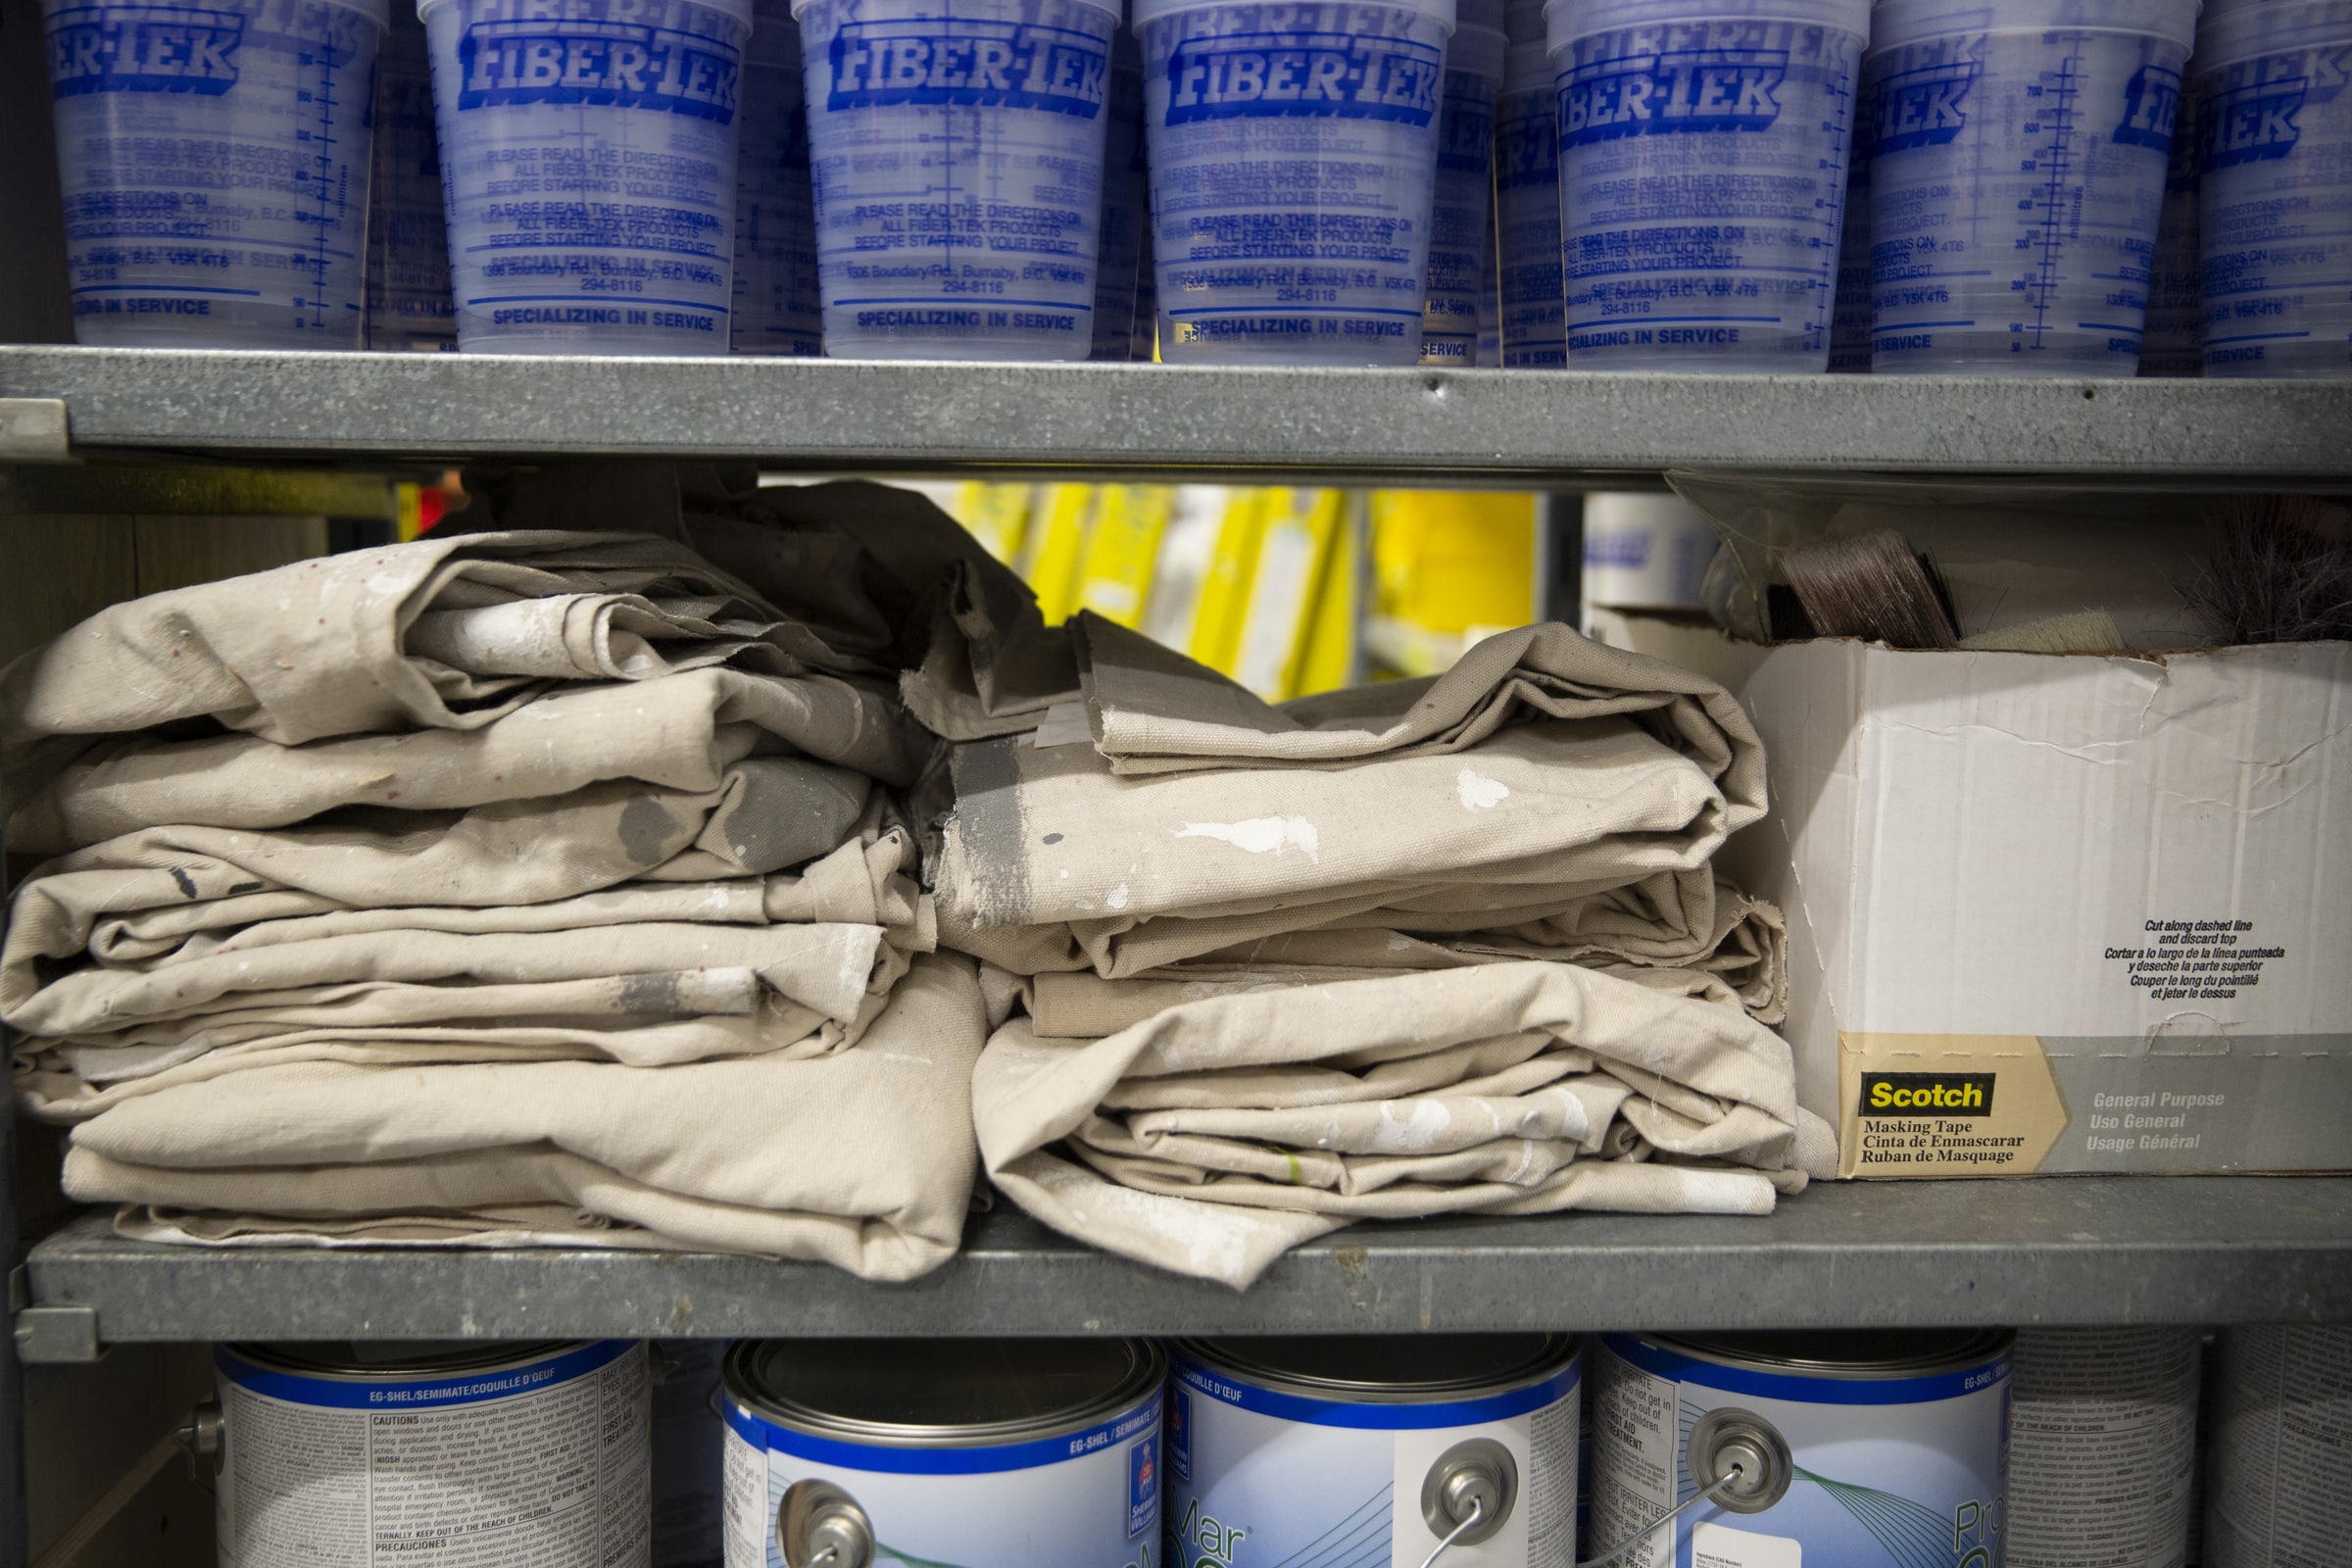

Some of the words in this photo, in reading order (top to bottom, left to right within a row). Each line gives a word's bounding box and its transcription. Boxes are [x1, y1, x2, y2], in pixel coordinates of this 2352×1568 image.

[463, 20, 739, 114] FIBER-TEK
[833, 19, 1107, 110] FIBER-TEK
[1170, 33, 1439, 116] FIBER-TEK
[490, 201, 541, 216] PLEASE
[544, 202, 586, 216] READ
[590, 202, 620, 217] THE
[625, 205, 703, 225] DIRECTIONS
[516, 217, 541, 229] ALL
[544, 217, 624, 231] FIBER-TEK
[628, 220, 699, 239] PRODUCTS
[1190, 216, 1240, 230] PLEASE
[1243, 214, 1282, 227] READ
[1286, 214, 1316, 227] THE
[1320, 215, 1396, 231] DIRECTIONS
[1399, 219, 1412, 232] ON
[942, 279, 1004, 293] 294-8116
[126, 299, 210, 316] SERVICE
[494, 308, 620, 325] SPECIALIZING
[627, 310, 647, 325] IN
[653, 311, 713, 331] SERVICE
[858, 310, 980, 327] SPECIALIZING
[988, 312, 1007, 327] IN
[1013, 313, 1074, 331] SERVICE
[1192, 319, 1311, 335] SPECIALIZING
[1319, 320, 1338, 335] IN
[1344, 320, 1404, 337] SERVICE
[1636, 329, 1652, 344] IN
[1658, 328, 1740, 344] SERVICE
[2145, 920, 2164, 931] Cut
[2165, 920, 2193, 933] along
[2195, 920, 2231, 931] dashed
[2233, 920, 2253, 931] line
[2159, 934, 2180, 944] and
[2180, 934, 2218, 944] discard
[2220, 934, 2237, 946] top
[2104, 948, 2137, 958] Cortar
[2146, 948, 2156, 958] lo
[2158, 948, 2184, 960] largo
[2186, 948, 2198, 958] de
[2201, 948, 2211, 958] la
[2213, 948, 2236, 958] línea
[2238, 947, 2285, 960] punteada
[2128, 964, 2135, 973] y
[2136, 961, 2180, 972] deseche
[2181, 961, 2191, 971] la
[2192, 961, 2220, 973] parte
[2221, 961, 2263, 973] superior
[2131, 975, 2167, 988] Couper
[2169, 975, 2178, 986] le
[2180, 975, 2202, 988] long
[2204, 975, 2216, 986] du
[2218, 974, 2260, 988] pointillé
[2151, 988, 2162, 999] et
[2161, 988, 2187, 1001] jeter
[2189, 988, 2198, 999] le
[2200, 988, 2236, 999] dessus
[1870, 1082, 1984, 1108] Scotch
[2093, 1092, 2155, 1107] General
[2160, 1092, 2226, 1109] Purpose
[1864, 1120, 1931, 1134] Masking
[1936, 1120, 1973, 1134] Tape
[2090, 1114, 2119, 1129] Uso
[2124, 1113, 2185, 1129] General
[1863, 1135, 1905, 1148] Cinta
[1909, 1135, 1927, 1148] de
[1931, 1135, 2025, 1149] Enmascarar
[2086, 1136, 2134, 1153] Usage
[2139, 1134, 2200, 1150] Général
[1861, 1150, 1911, 1163] Ruban
[1915, 1150, 1934, 1162] de
[1936, 1150, 2014, 1164] Masquage
[369, 1376, 521, 1402] EG-SHEL/SEMIMATE/COQUILLE
[522, 1367, 555, 1386] D'OEUF
[1965, 1370, 1992, 1390] EG-SHEL
[1625, 1380, 1635, 1395] Do
[1635, 1388, 1647, 1401] not
[1648, 1395, 1661, 1408] get
[1663, 1397, 1671, 1411] in
[373, 1415, 418, 1426] CAUTIONS
[436, 1415, 451, 1424] only
[453, 1412, 467, 1421] with
[468, 1407, 499, 1420] adequate
[501, 1400, 535, 1413] ventilation.
[544, 1392, 561, 1403] avoid
[1639, 1402, 1650, 1416] out
[1653, 1409, 1661, 1421] of
[1069, 1430, 1109, 1454] EG-SHEL
[1115, 1409, 1152, 1440] SEMIMATE
[1624, 1420, 1636, 1436] AID
[1630, 1410, 1662, 1435] children.
[1621, 1486, 1649, 1513] IRRITER
[416, 1529, 435, 1539] KEEP
[437, 1527, 452, 1537] OUT
[454, 1526, 464, 1535] OF
[466, 1523, 480, 1532] THE
[482, 1518, 506, 1529] REACH
[508, 1515, 517, 1524] OF
[375, 1539, 447, 1552] PRECAUCIONES
